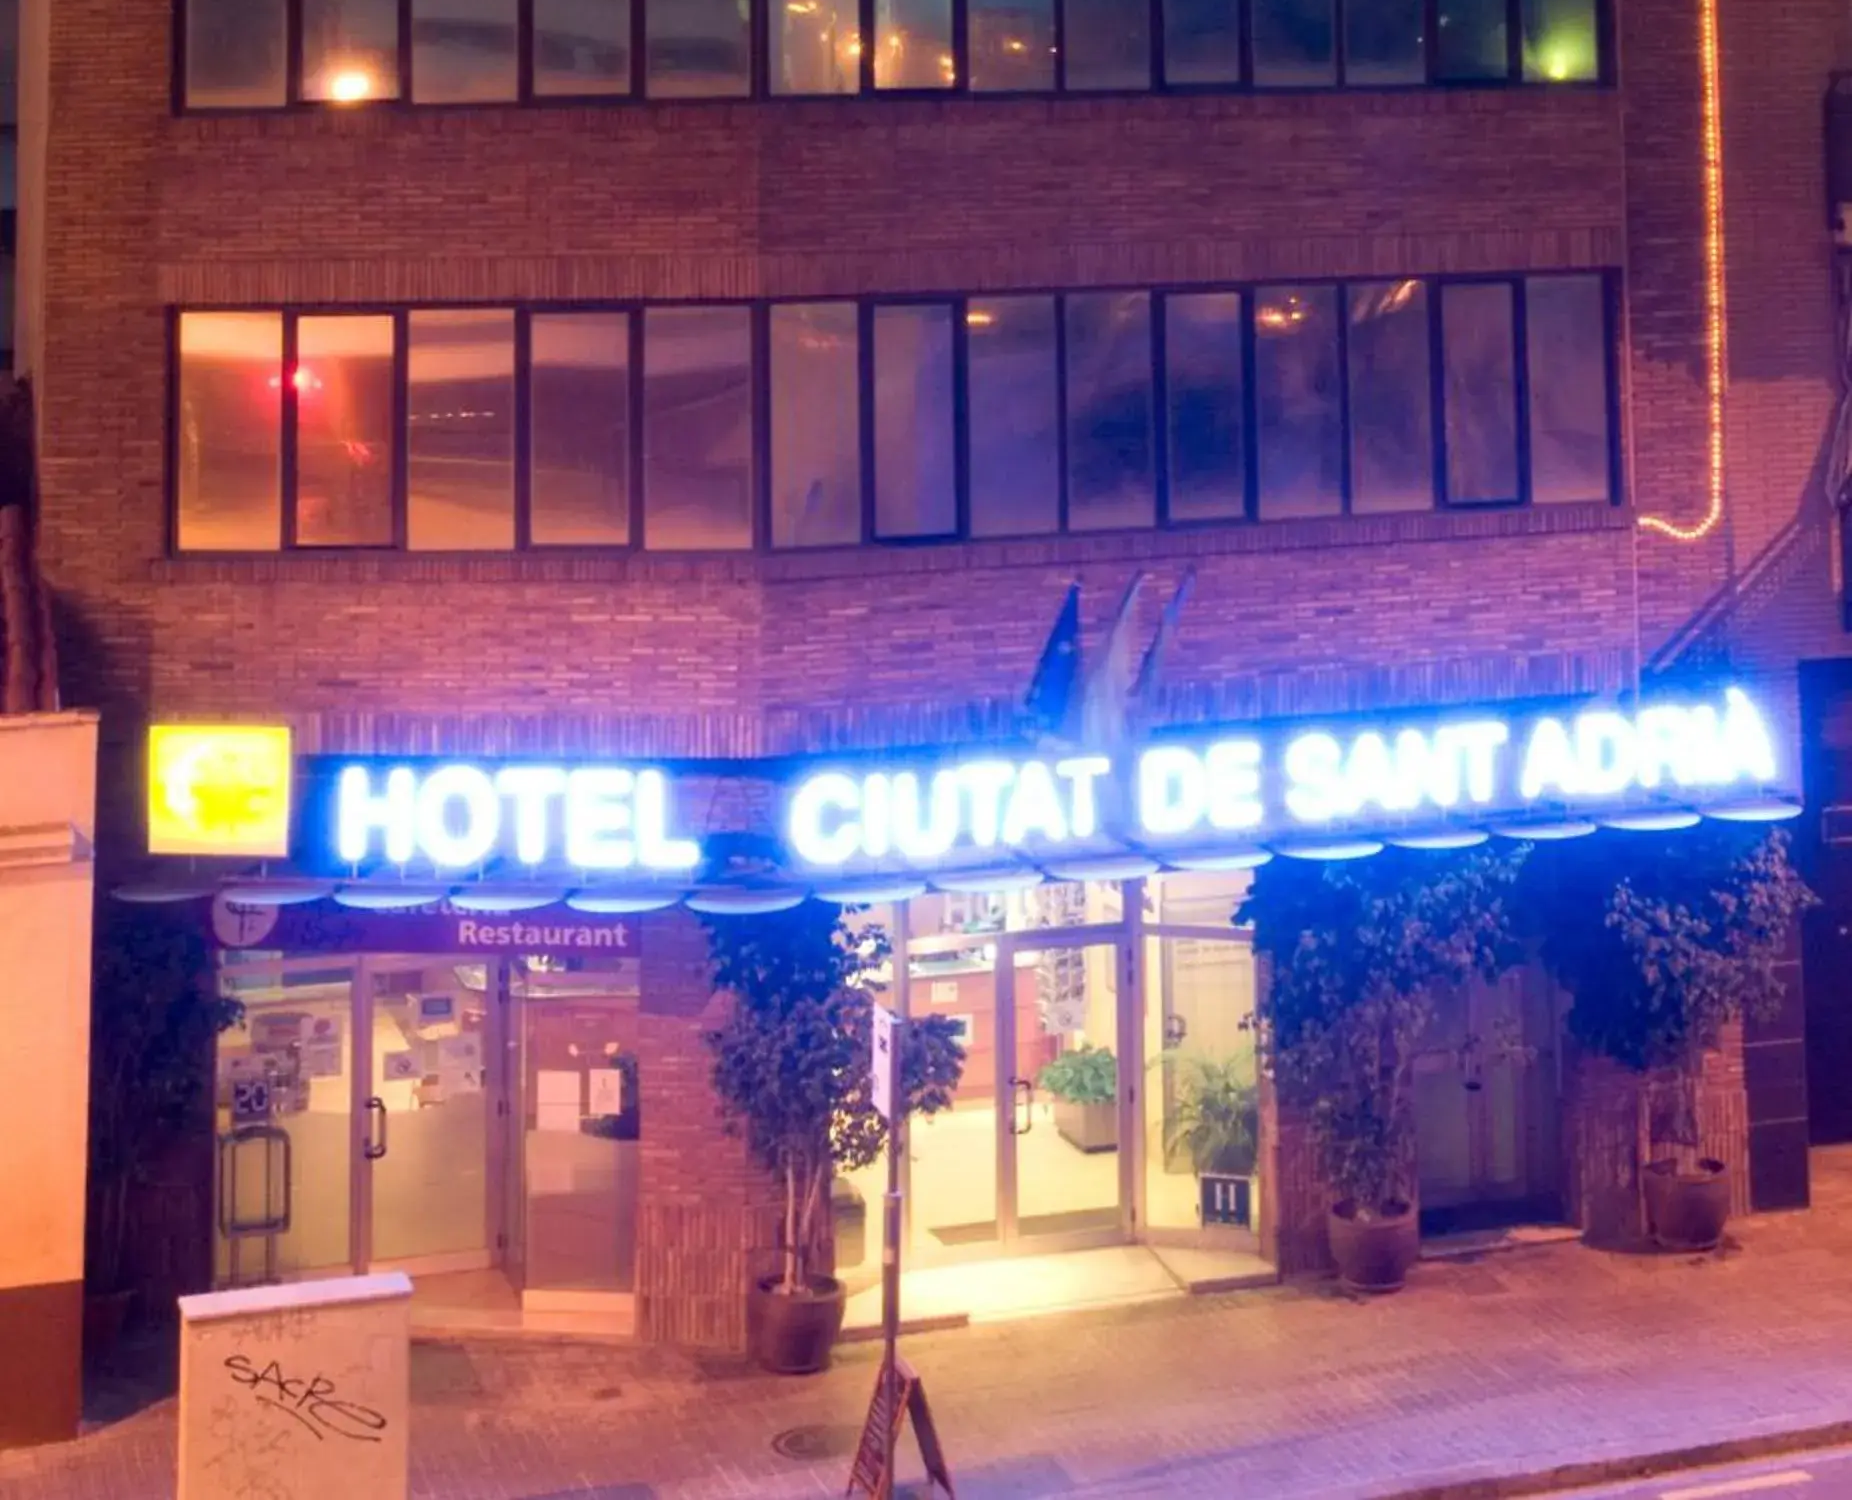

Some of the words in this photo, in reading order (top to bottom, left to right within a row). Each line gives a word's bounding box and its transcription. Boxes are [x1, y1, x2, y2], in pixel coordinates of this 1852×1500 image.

[339, 766, 699, 869] HOTEL
[789, 757, 1110, 865] CIUTAT
[1139, 741, 1264, 837] DE
[1284, 722, 1507, 822] SANT
[458, 919, 628, 948] Restaurant
